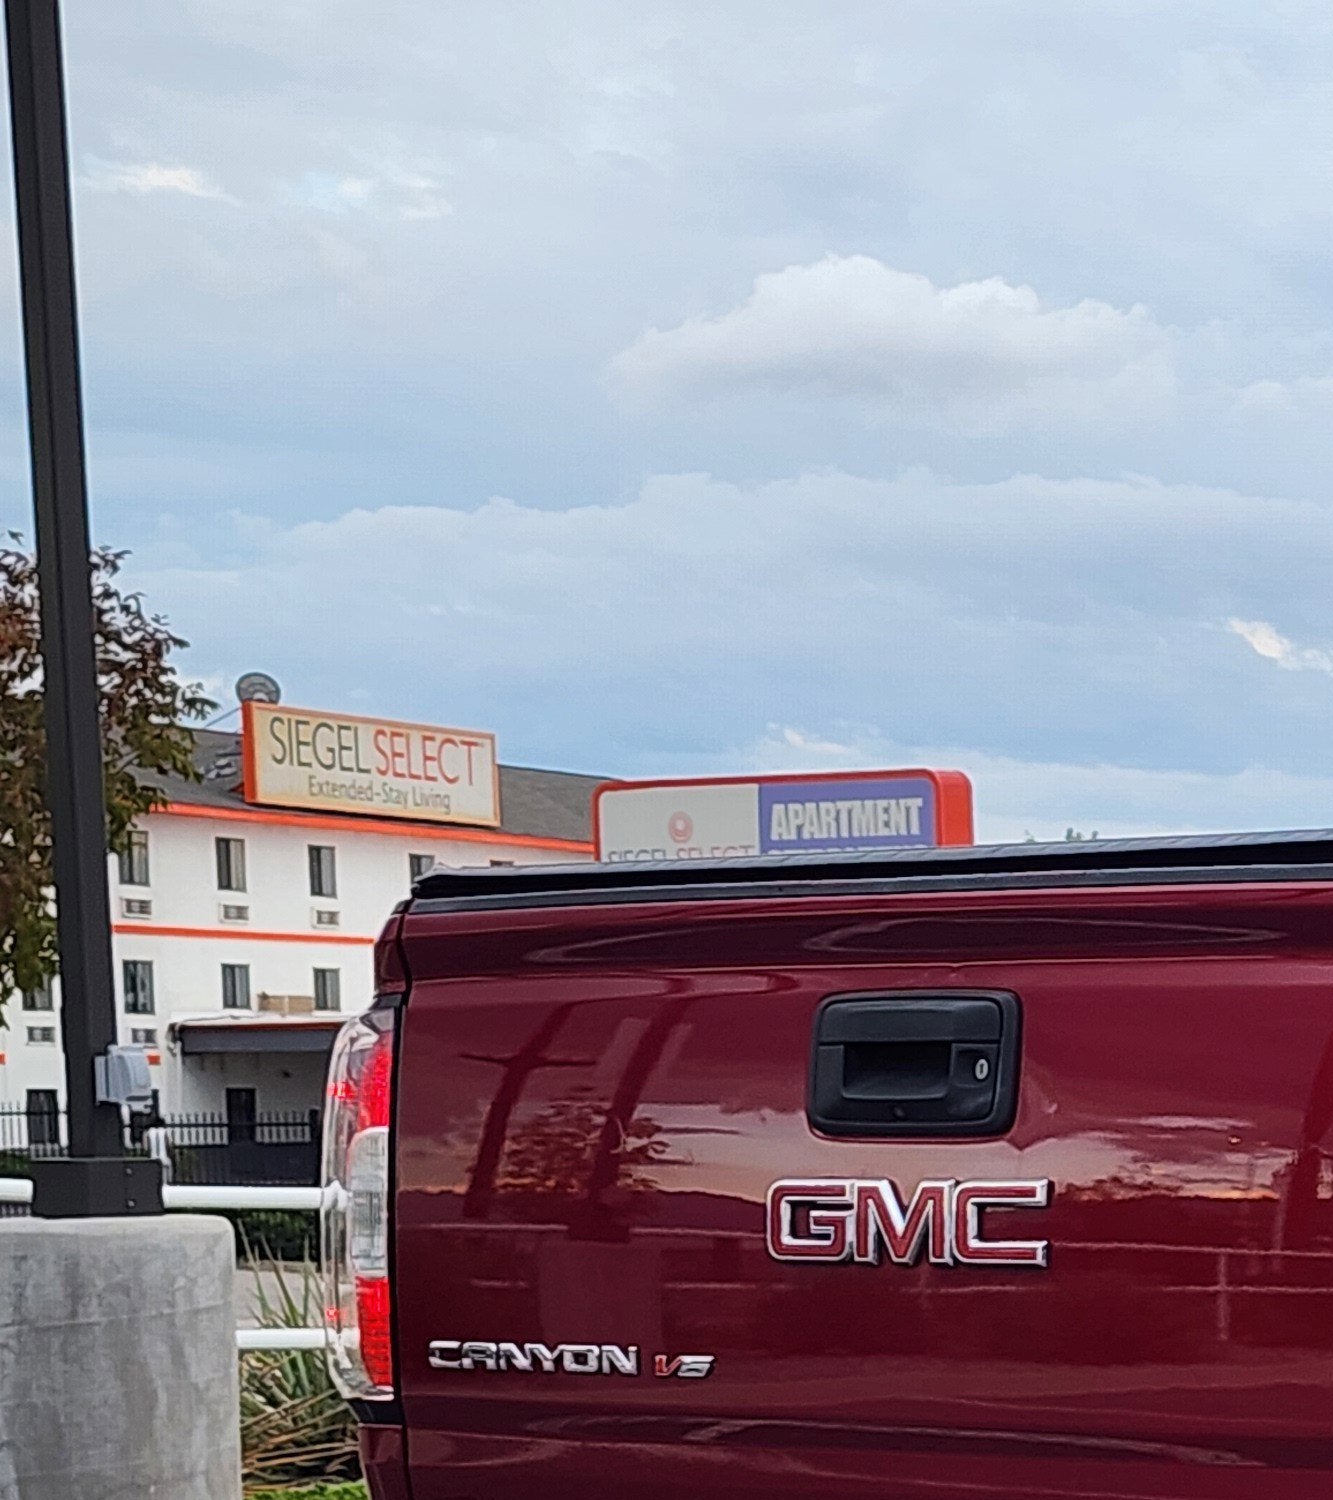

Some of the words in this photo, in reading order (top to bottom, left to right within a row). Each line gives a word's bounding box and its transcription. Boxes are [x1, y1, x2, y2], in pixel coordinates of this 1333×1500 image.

[269, 716, 372, 775] SIEGEL
[372, 728, 479, 786] SELECT
[308, 774, 409, 810] Extended-Stay
[412, 787, 451, 816] Living
[770, 797, 924, 842] APARTMENT
[767, 1178, 1049, 1267] GMC
[428, 1340, 638, 1375] CANYON
[655, 1354, 715, 1377] V6
